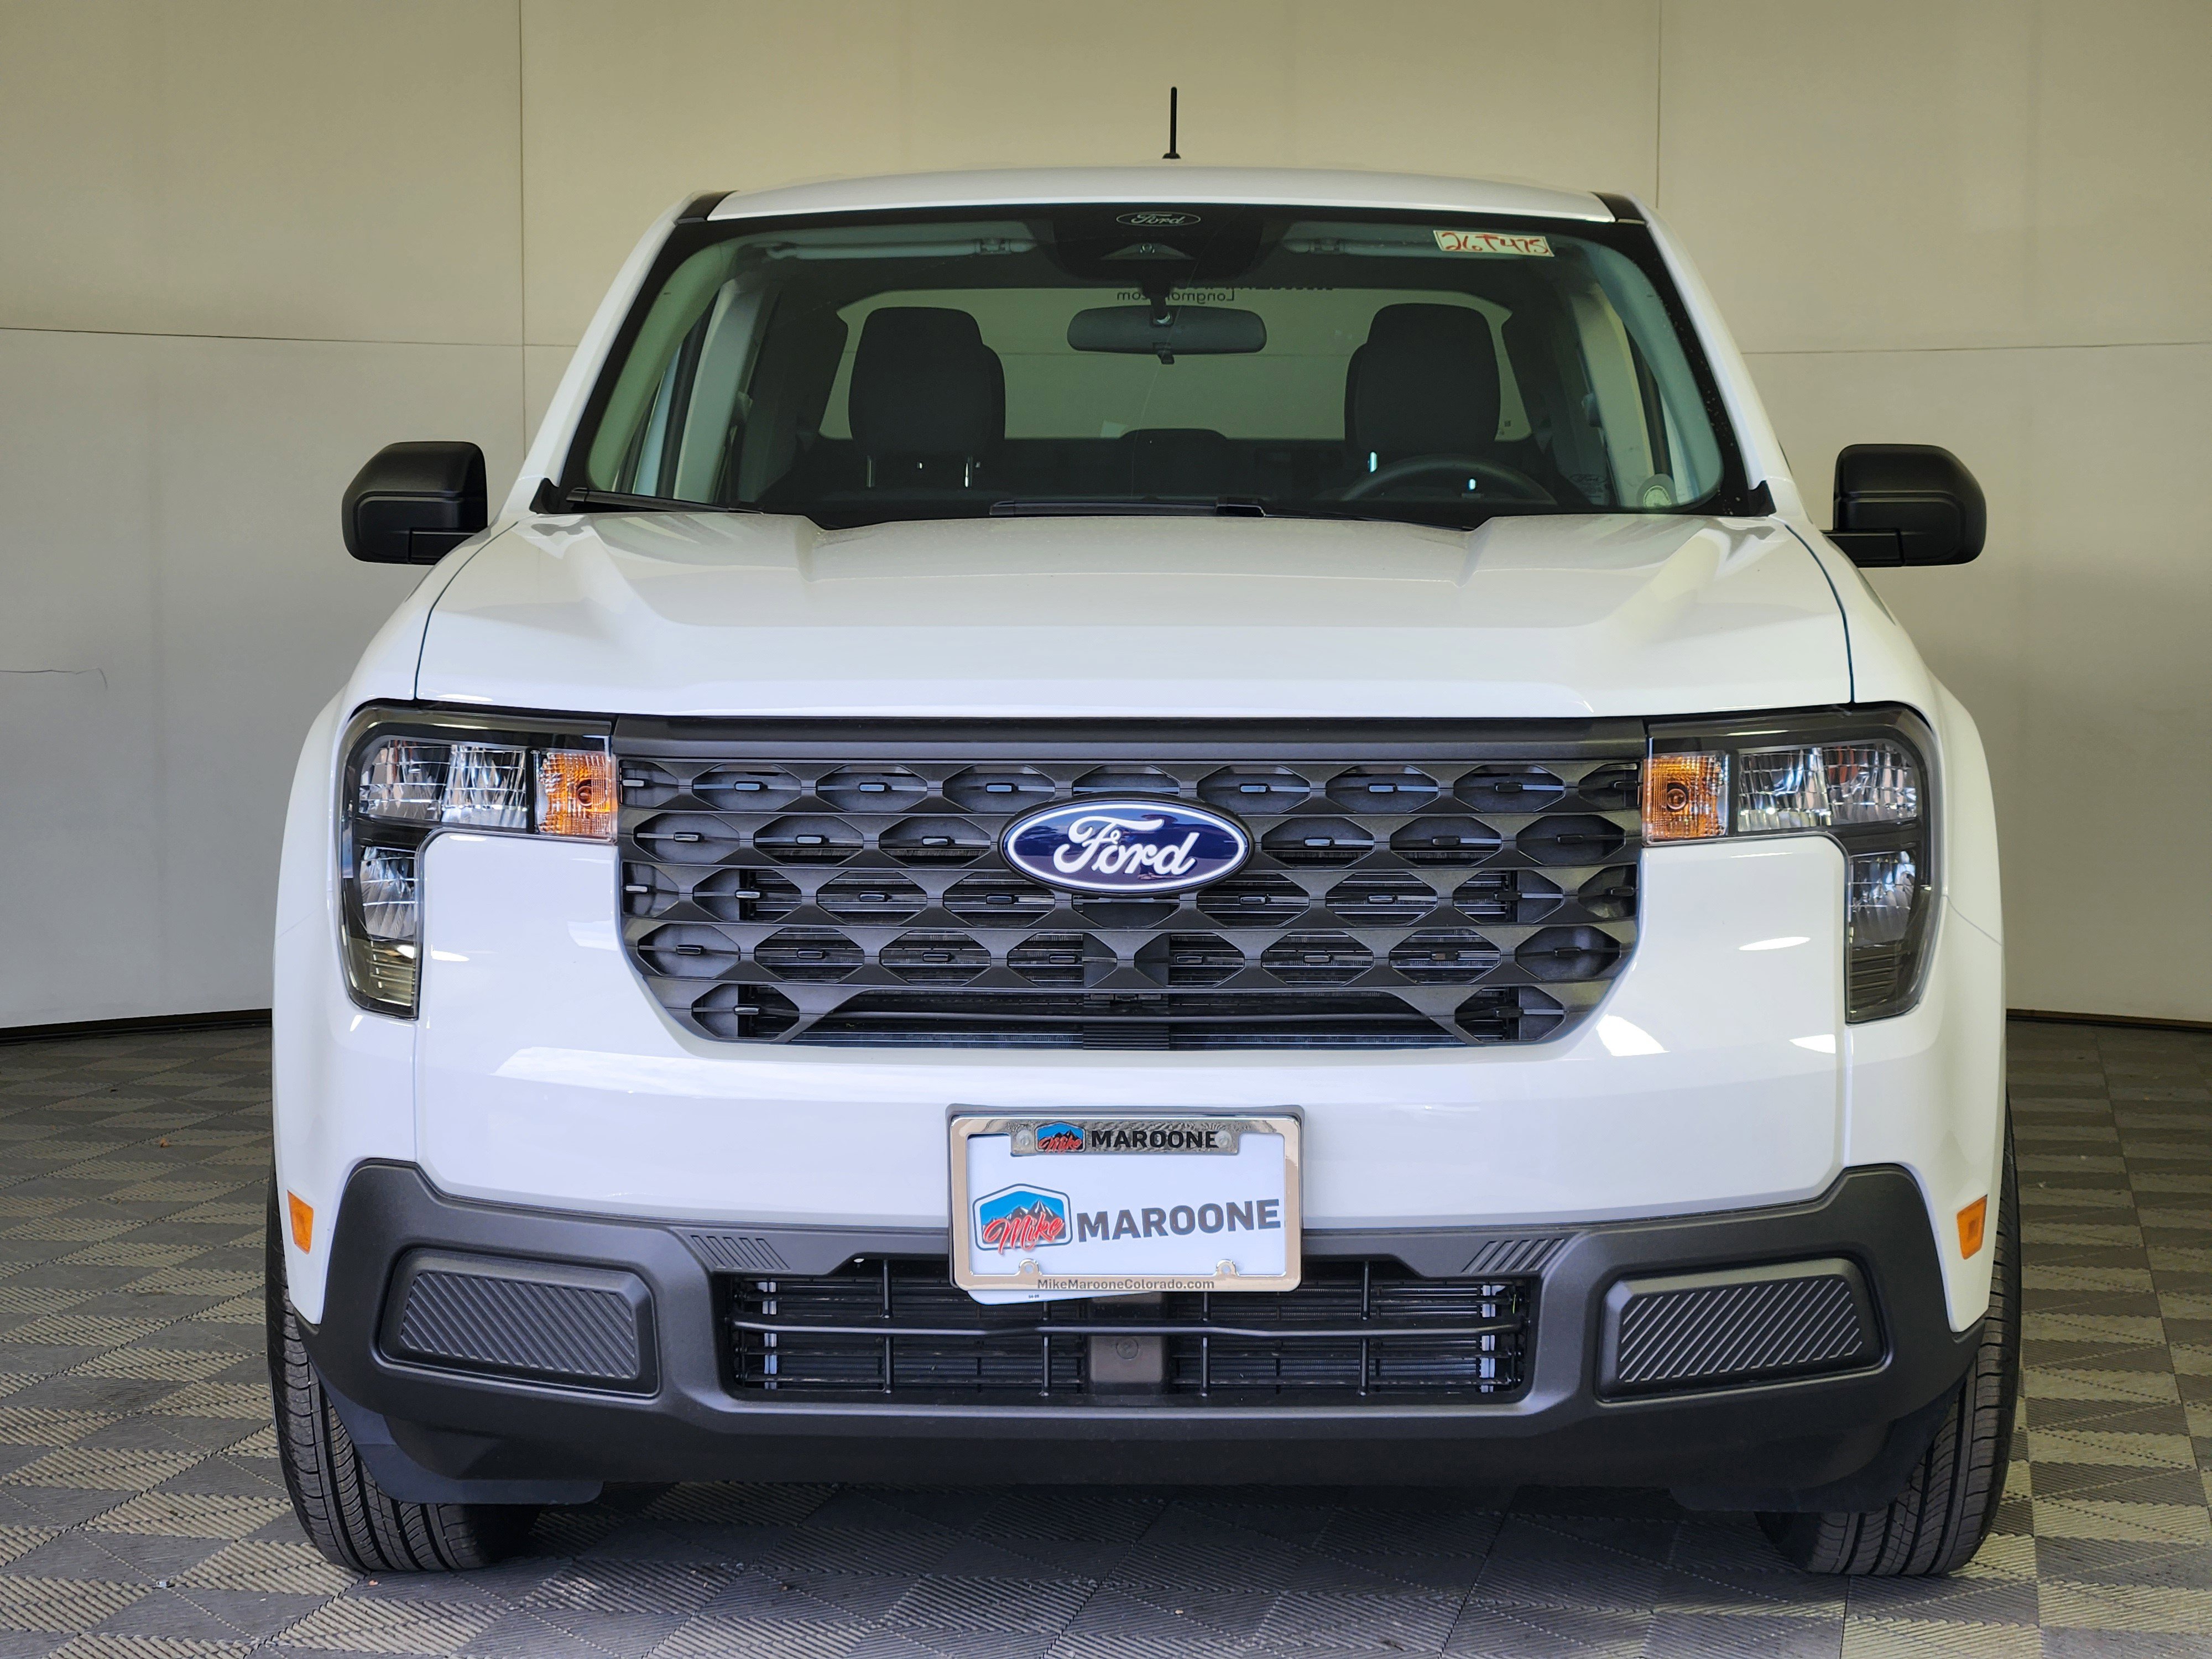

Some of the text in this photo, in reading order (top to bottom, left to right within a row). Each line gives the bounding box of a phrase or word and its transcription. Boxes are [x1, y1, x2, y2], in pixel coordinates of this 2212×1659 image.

[1131, 214, 1186, 224] Ford
[1441, 232, 1548, 253] 26T475
[1053, 816, 1199, 875] Ford
[1039, 1130, 1219, 1154] Mike MAROONE
[982, 1198, 1281, 1255] Mike MAROONE
[1037, 1279, 1214, 1290] MikeMarooneColorado.com
